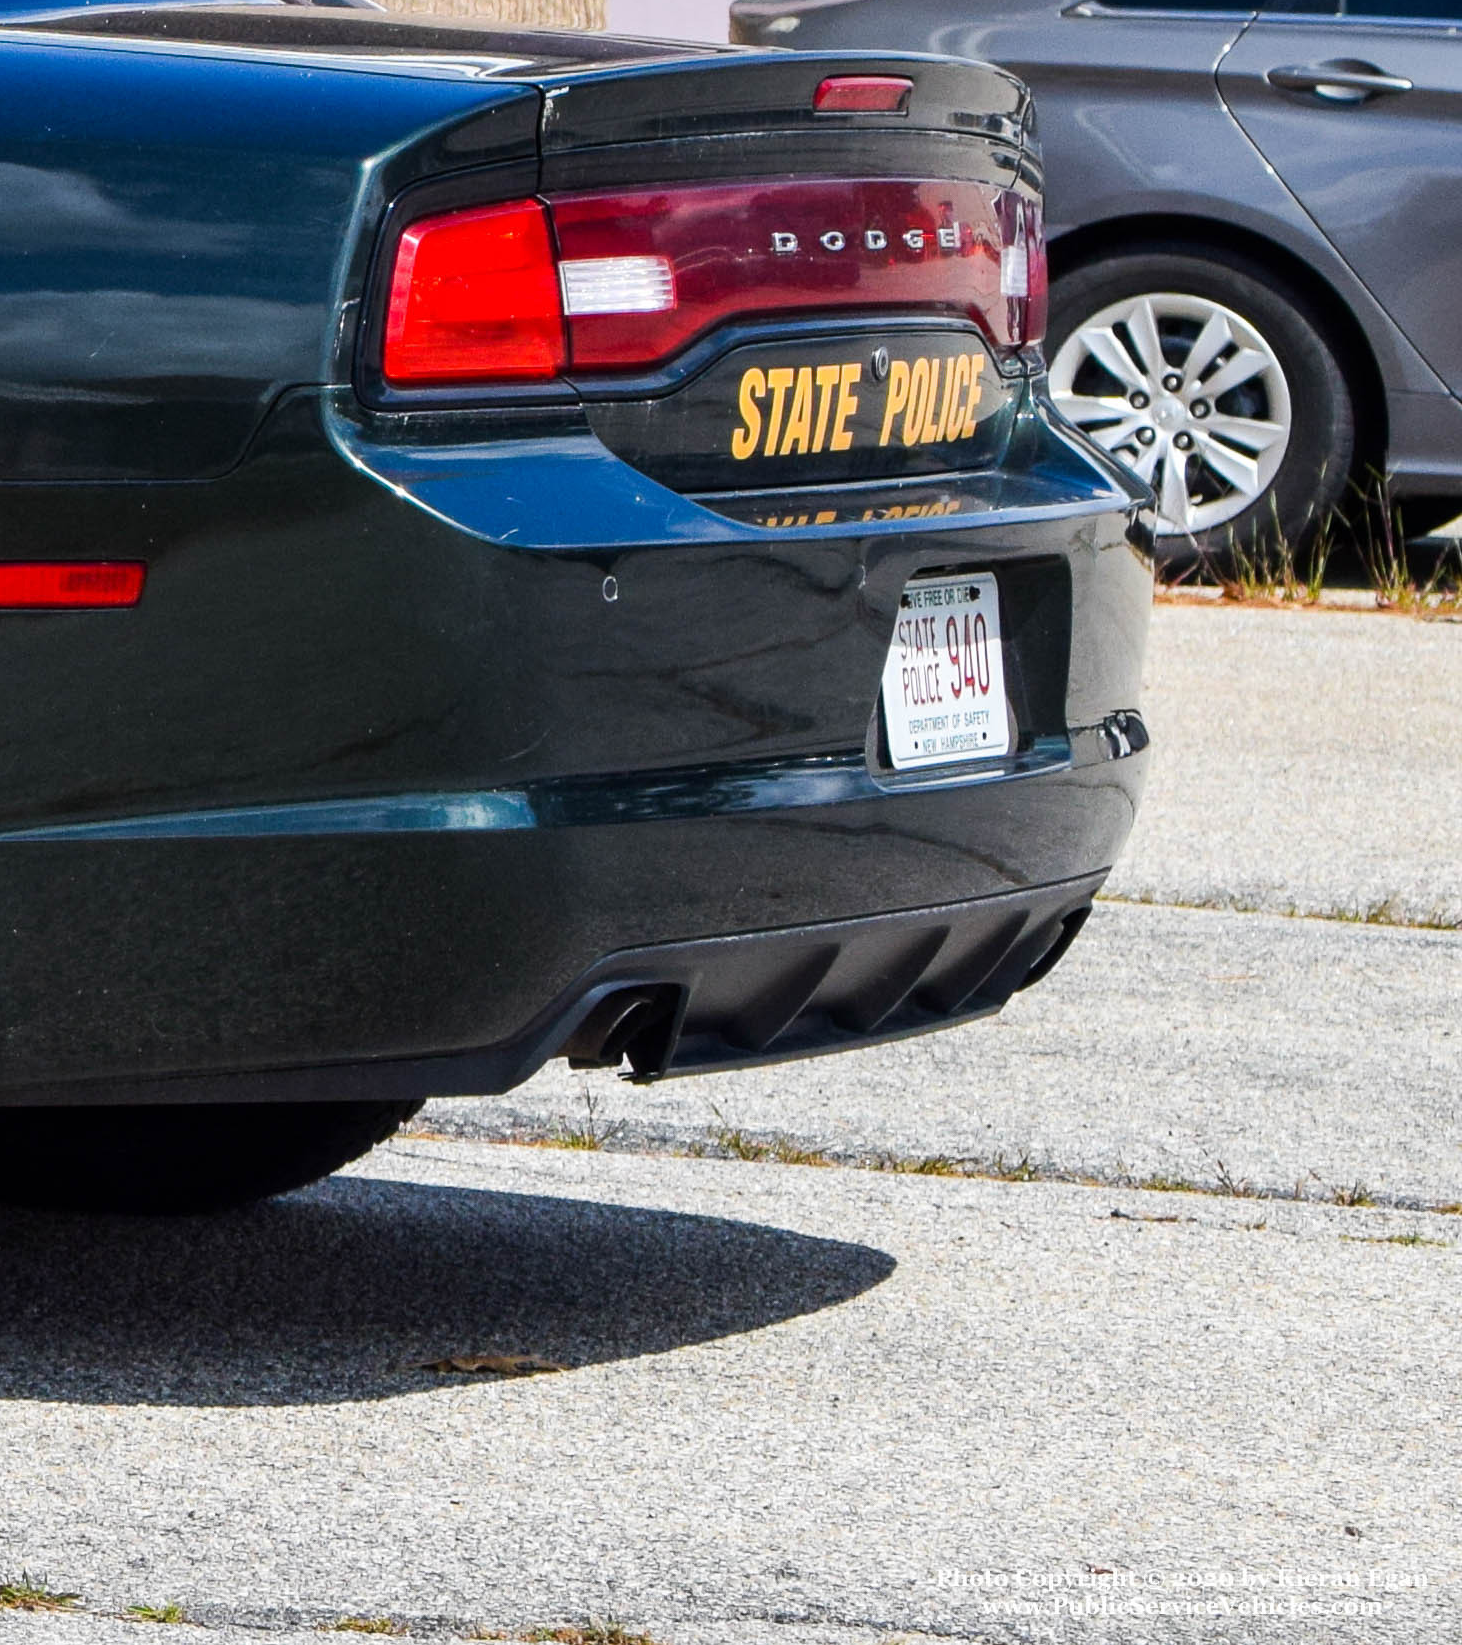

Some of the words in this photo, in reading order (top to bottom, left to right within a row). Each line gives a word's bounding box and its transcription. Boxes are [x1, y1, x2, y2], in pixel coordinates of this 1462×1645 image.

[772, 228, 960, 253] DODGE
[732, 363, 861, 460] STATE
[879, 354, 984, 447] POLICE
[924, 588, 943, 607] FREE
[944, 587, 955, 605] OR
[899, 615, 938, 660] STATE
[946, 612, 990, 699] 940
[902, 663, 942, 707] POLICE
[909, 715, 949, 735] DEPARTMENT
[952, 713, 961, 729] OF
[964, 710, 990, 727] SAFETY
[922, 738, 937, 754] NEW
